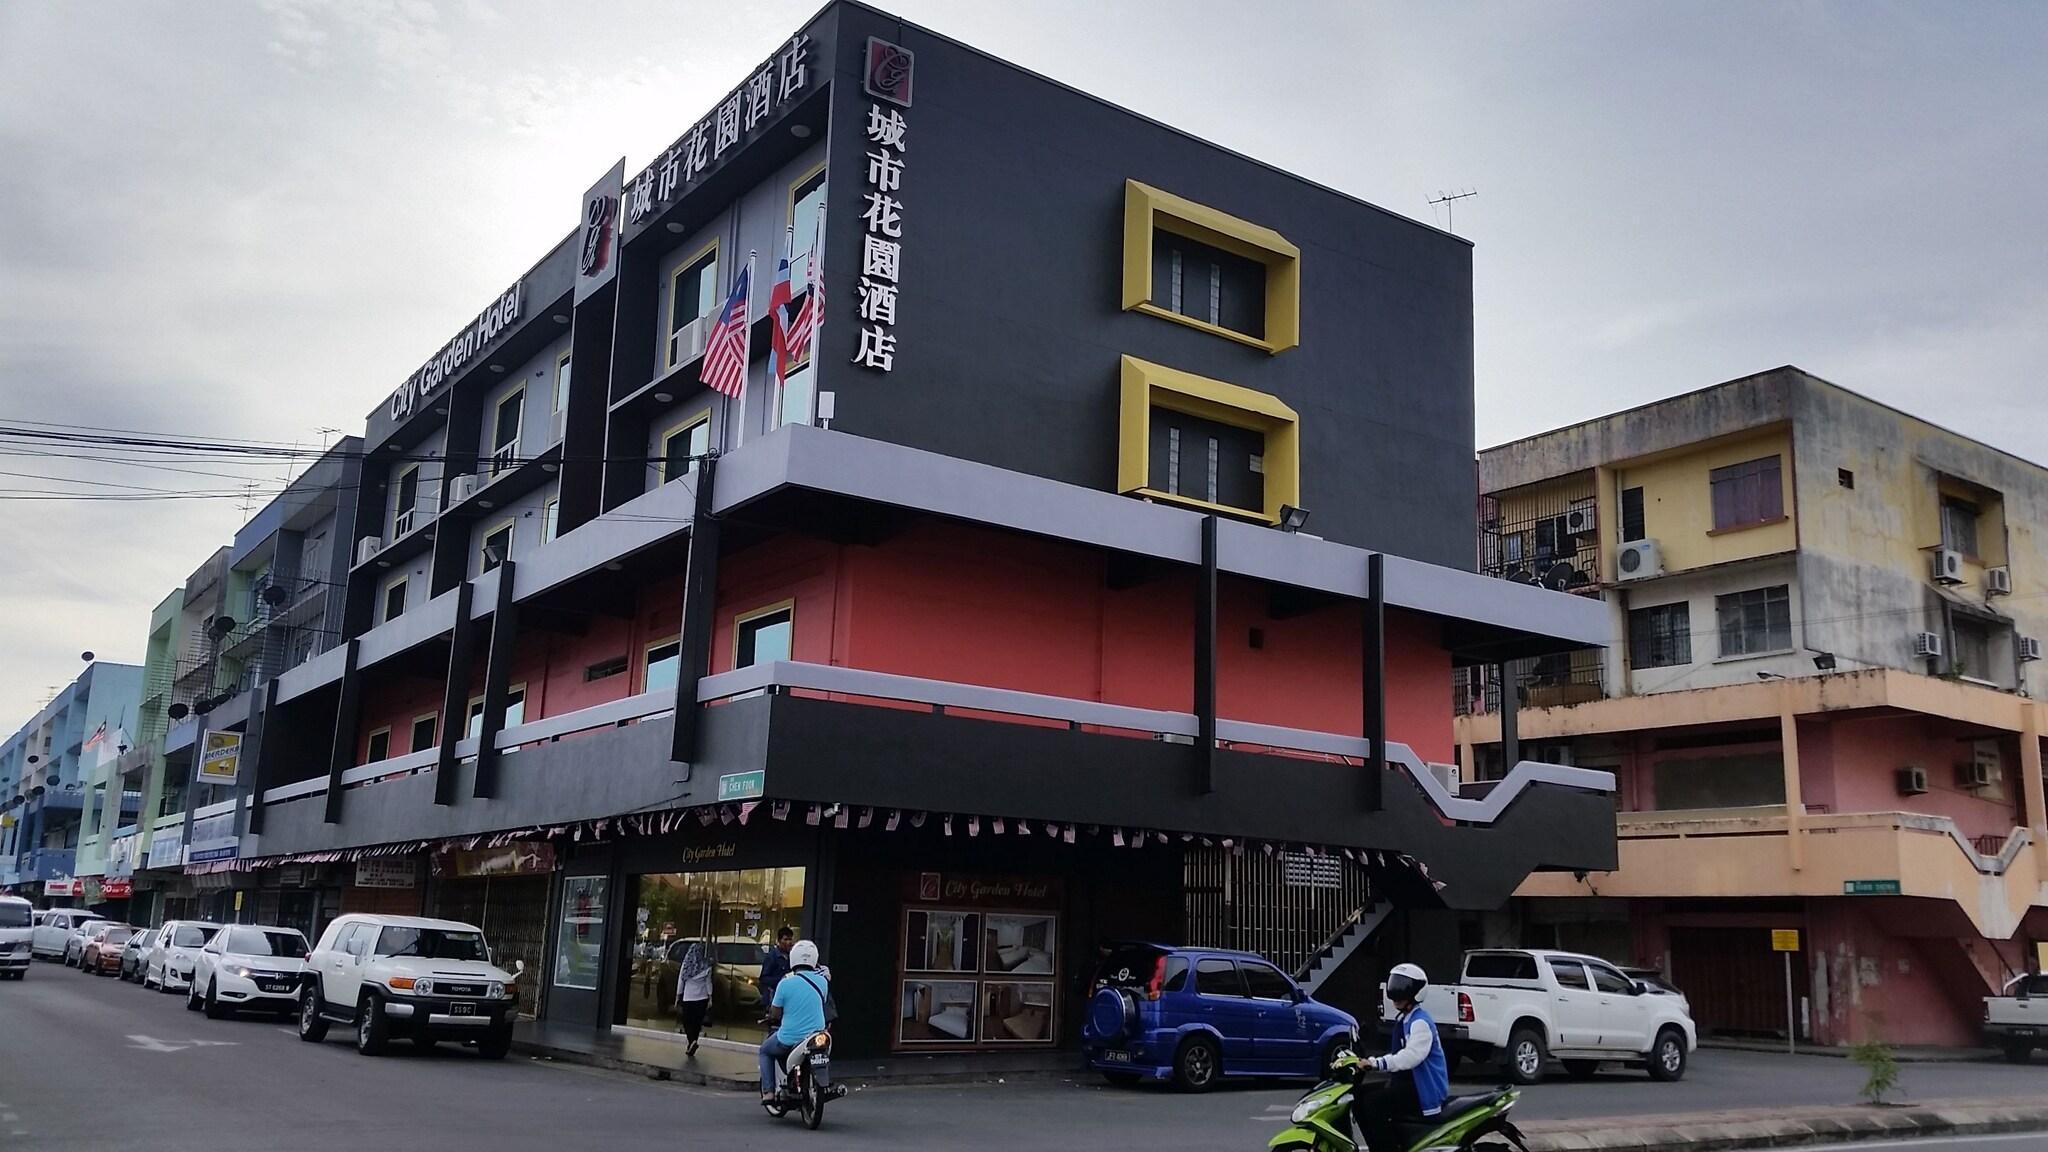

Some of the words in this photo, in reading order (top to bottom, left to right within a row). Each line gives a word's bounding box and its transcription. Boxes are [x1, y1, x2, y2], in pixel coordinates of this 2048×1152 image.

[630, 34, 810, 225] 城市花園酒店
[852, 104, 908, 372] 城市花園酒店
[391, 379, 418, 421] City
[420, 331, 474, 396] Garden
[476, 281, 523, 351] Hotel
[945, 880, 968, 898] City
[970, 880, 1011, 899] Garden
[1014, 881, 1048, 897] Hotel
